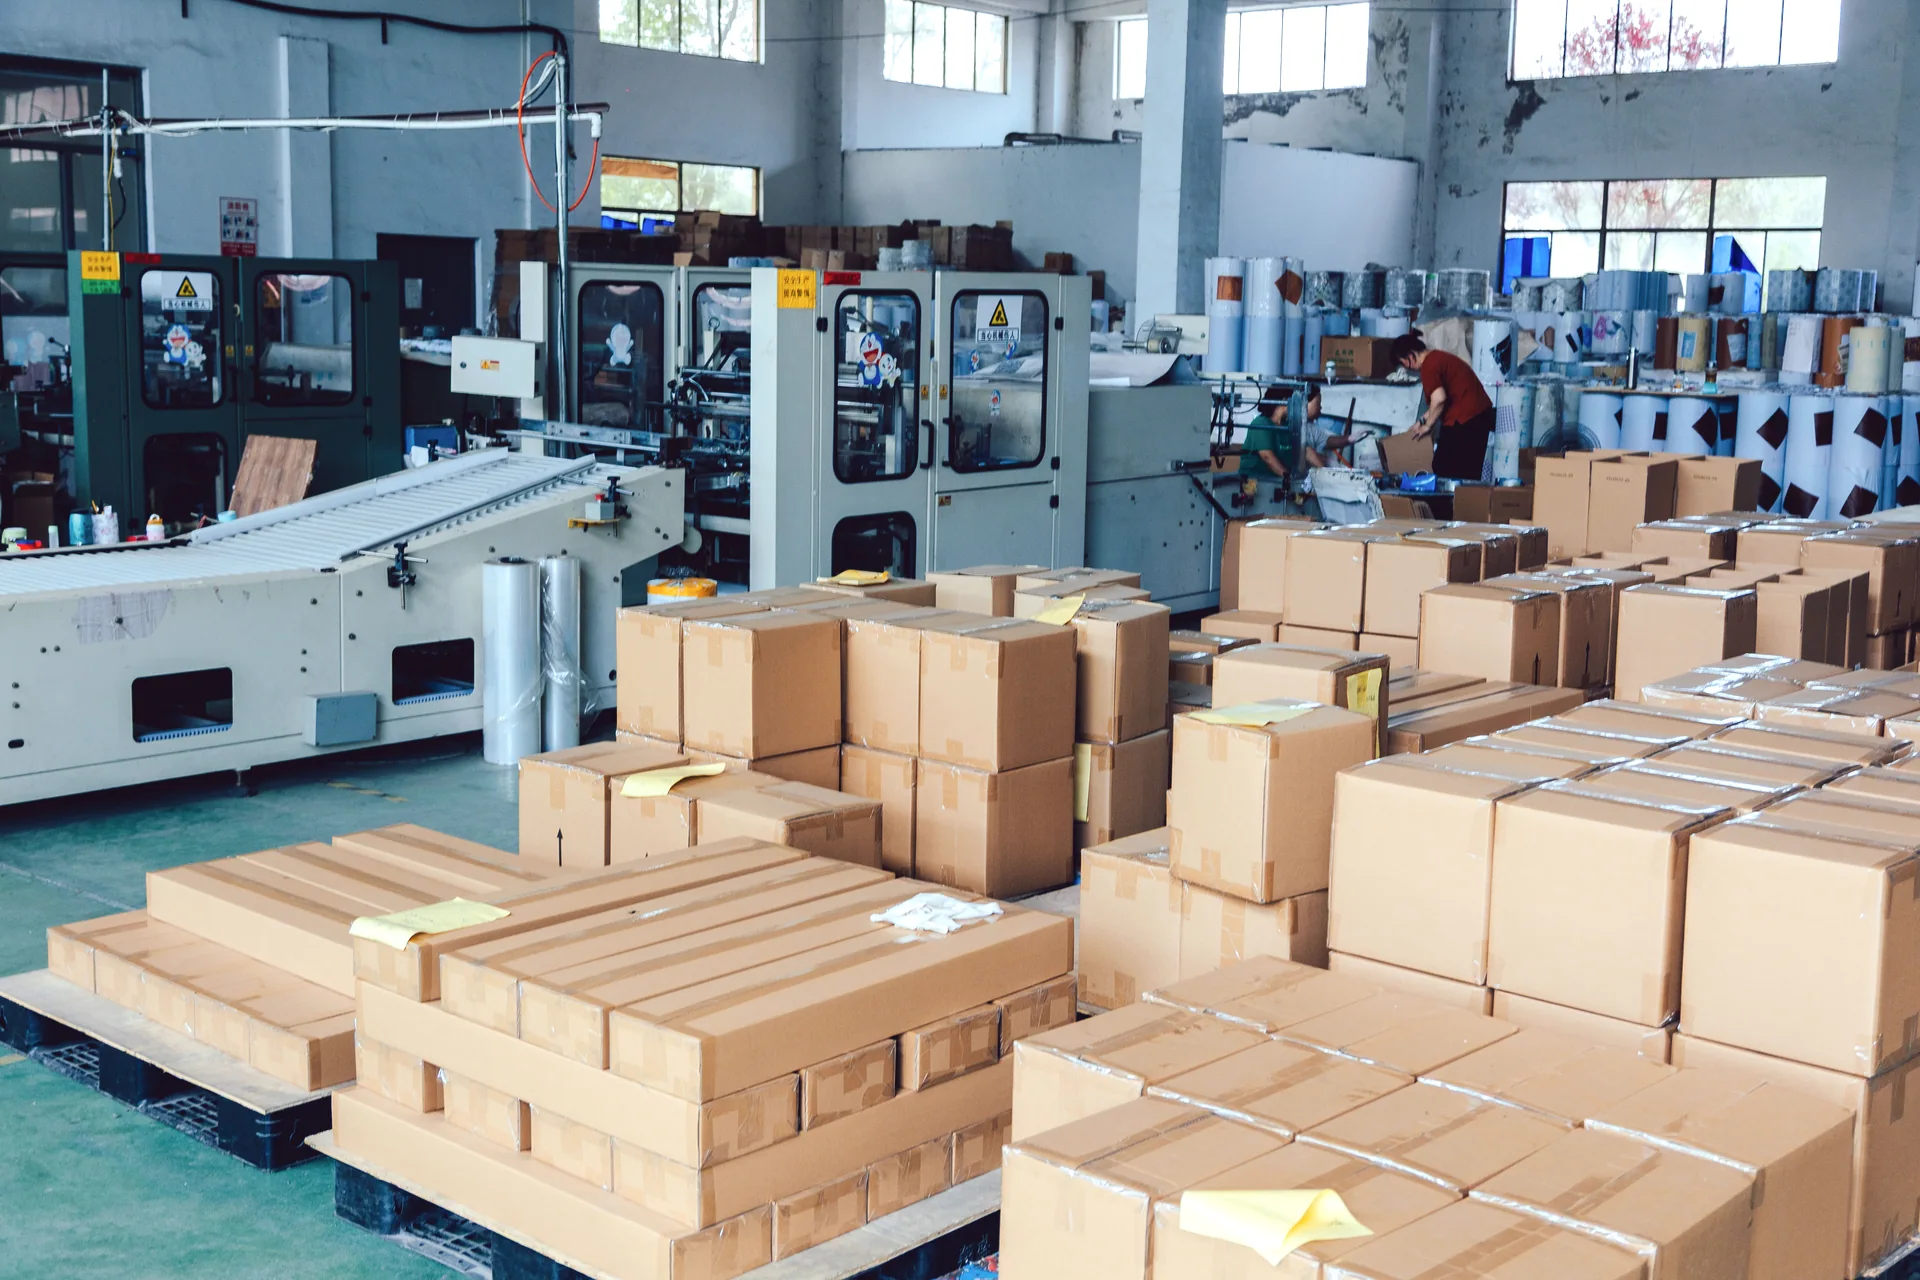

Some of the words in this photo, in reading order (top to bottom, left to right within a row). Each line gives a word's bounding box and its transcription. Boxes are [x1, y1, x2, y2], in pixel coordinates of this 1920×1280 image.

[783, 275, 810, 284] 安全生产
[980, 330, 1015, 342] 当心机械伤人
